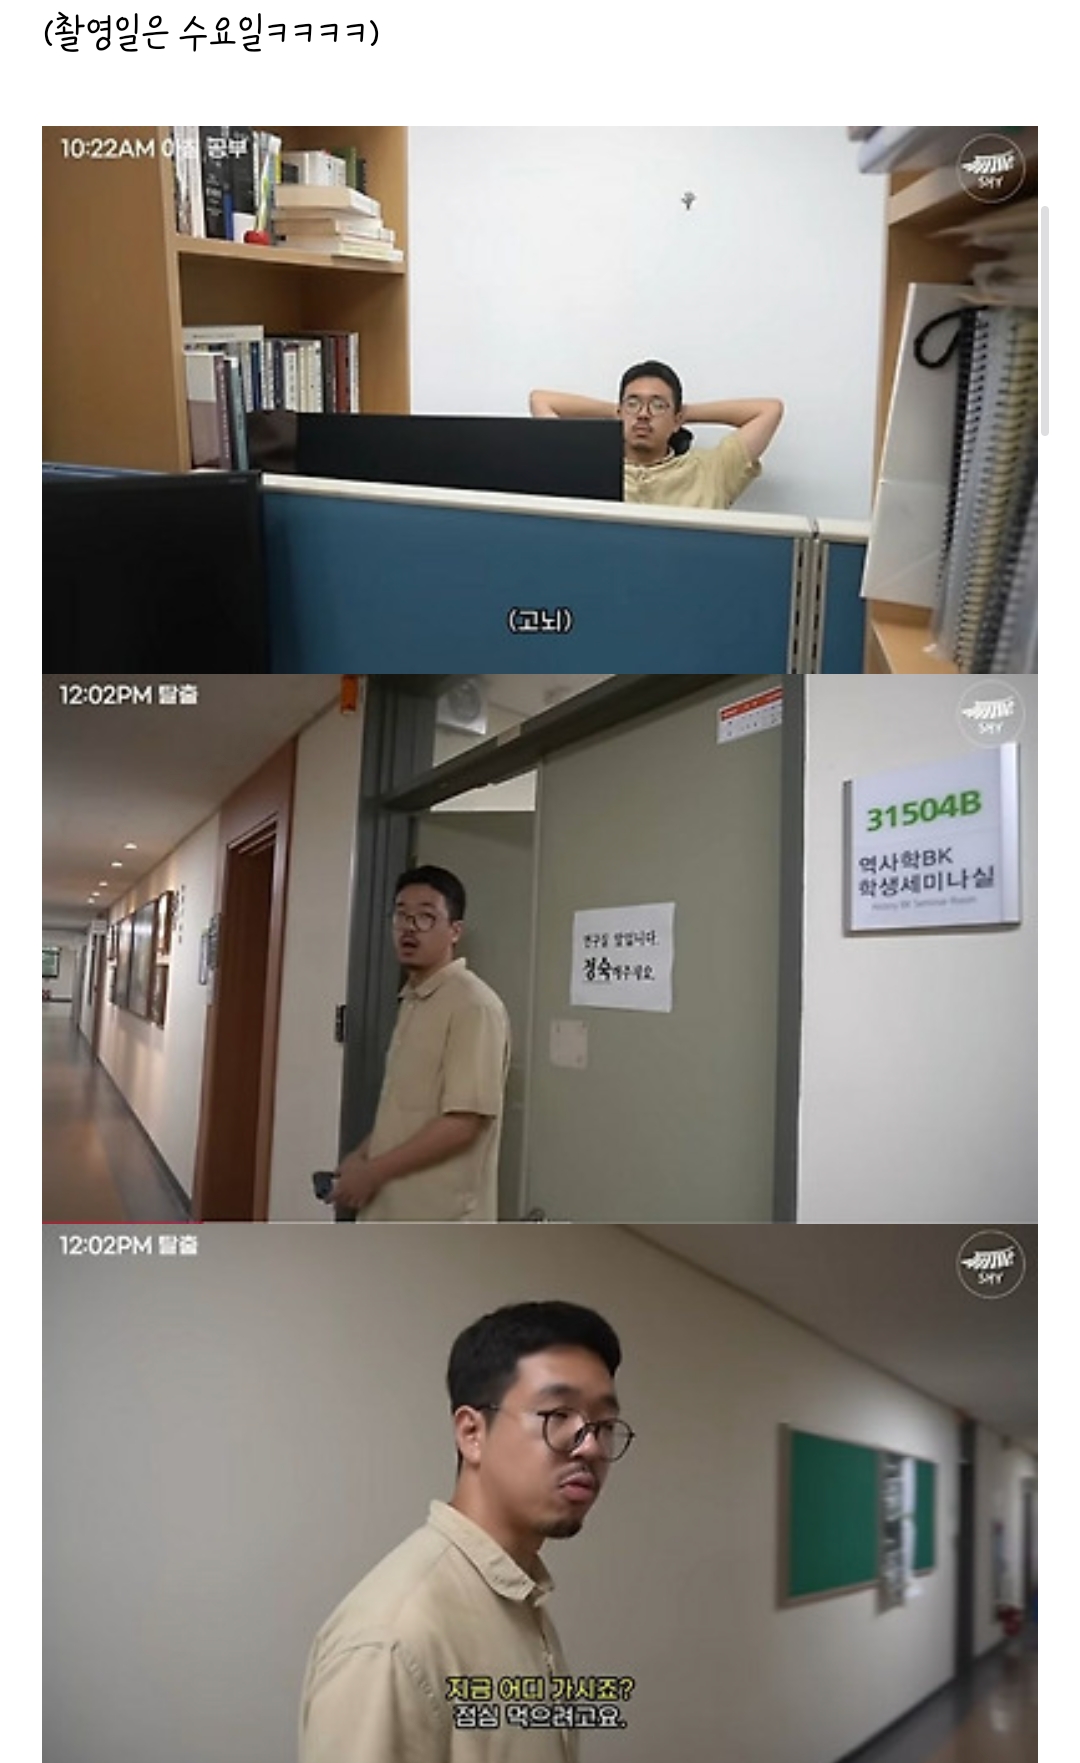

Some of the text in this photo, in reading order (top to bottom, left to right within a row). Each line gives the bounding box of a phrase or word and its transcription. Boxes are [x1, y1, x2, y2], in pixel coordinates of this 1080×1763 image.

[867, 790, 982, 832] 31504B
[859, 847, 953, 874] 역사학BK
[859, 865, 995, 897] 학생세미나실
